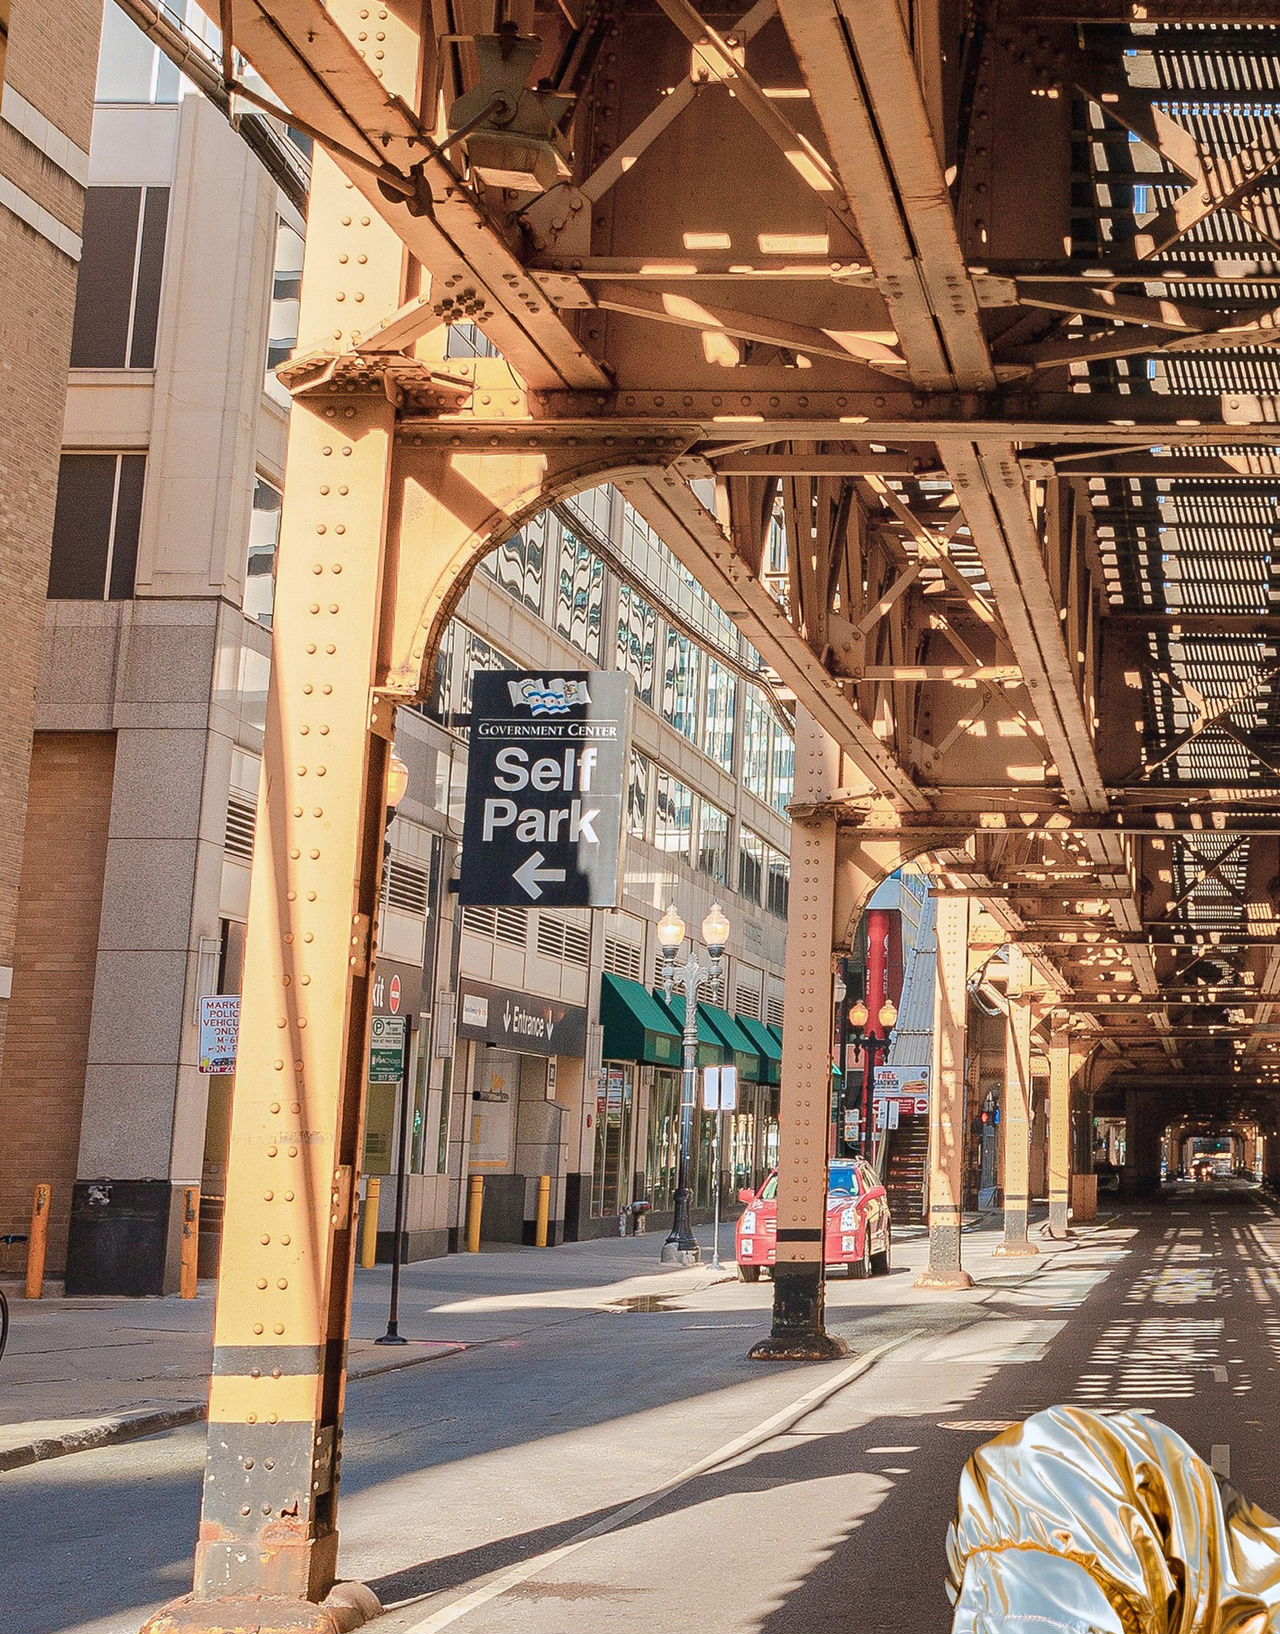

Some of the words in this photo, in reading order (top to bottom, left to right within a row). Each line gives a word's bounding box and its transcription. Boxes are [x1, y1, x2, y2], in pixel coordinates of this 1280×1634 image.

[478, 722, 565, 737] GOVERNMENT
[567, 723, 617, 737] CENTER
[494, 747, 598, 792] Self
[482, 798, 601, 843] Park
[206, 1001, 241, 1009] MARKE
[209, 1010, 239, 1018] POLIC
[513, 1005, 544, 1038] Entrance
[203, 1019, 239, 1027] VEHICL
